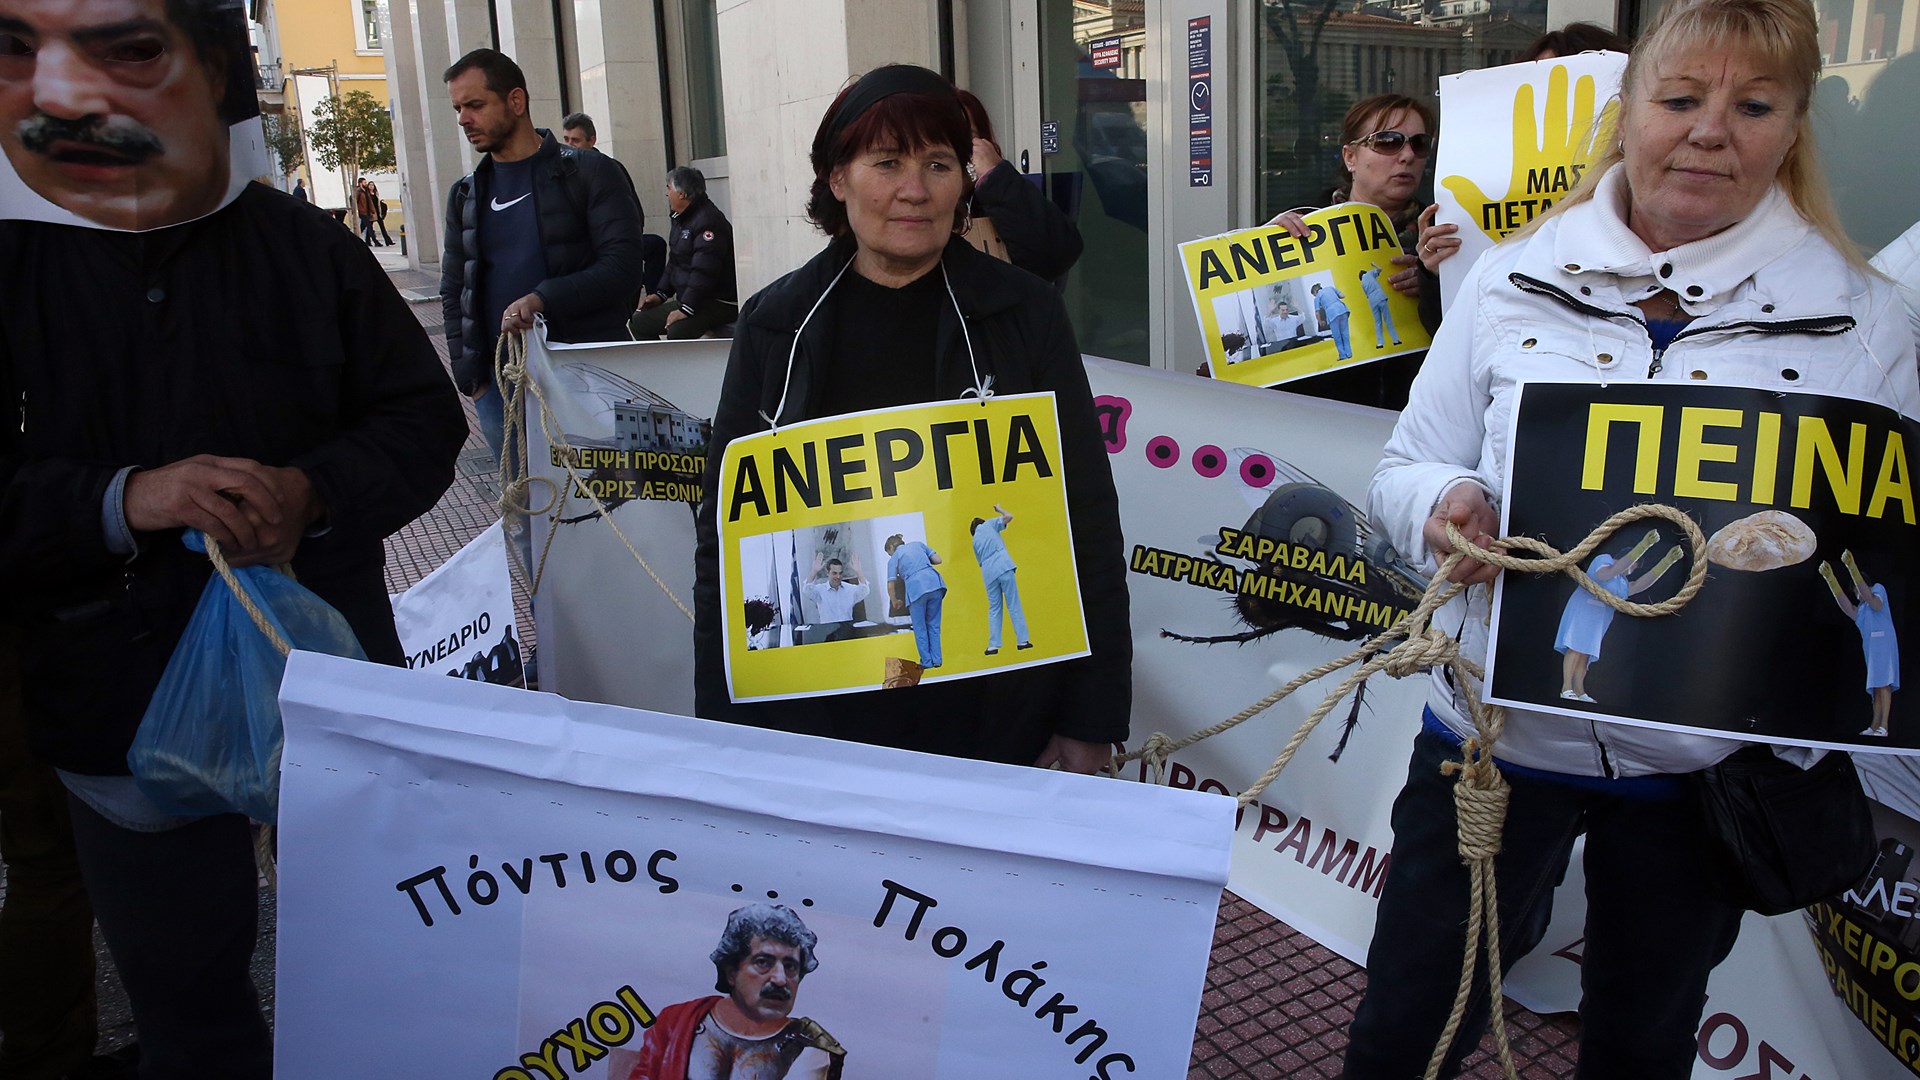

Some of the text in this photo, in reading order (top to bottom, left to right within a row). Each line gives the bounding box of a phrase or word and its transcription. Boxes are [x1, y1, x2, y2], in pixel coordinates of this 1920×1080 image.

[1526, 163, 1586, 195] ΜΑΣ
[1199, 212, 1397, 291] ΑΝΕΡΓΙΑ
[574, 478, 637, 500] ΧΩΡΙΣ
[728, 414, 1054, 523] ΑΝΕΡΓΙΑ
[1580, 402, 1917, 526] ΠΕΙΝΑ
[1131, 546, 1237, 592] ΙΑΤΡΙΚΑ
[1217, 528, 1367, 585] ΣΑΡΑΒΑΛΑ
[395, 848, 680, 928] Πόντιος
[872, 878, 1137, 1080] Πολάκης
